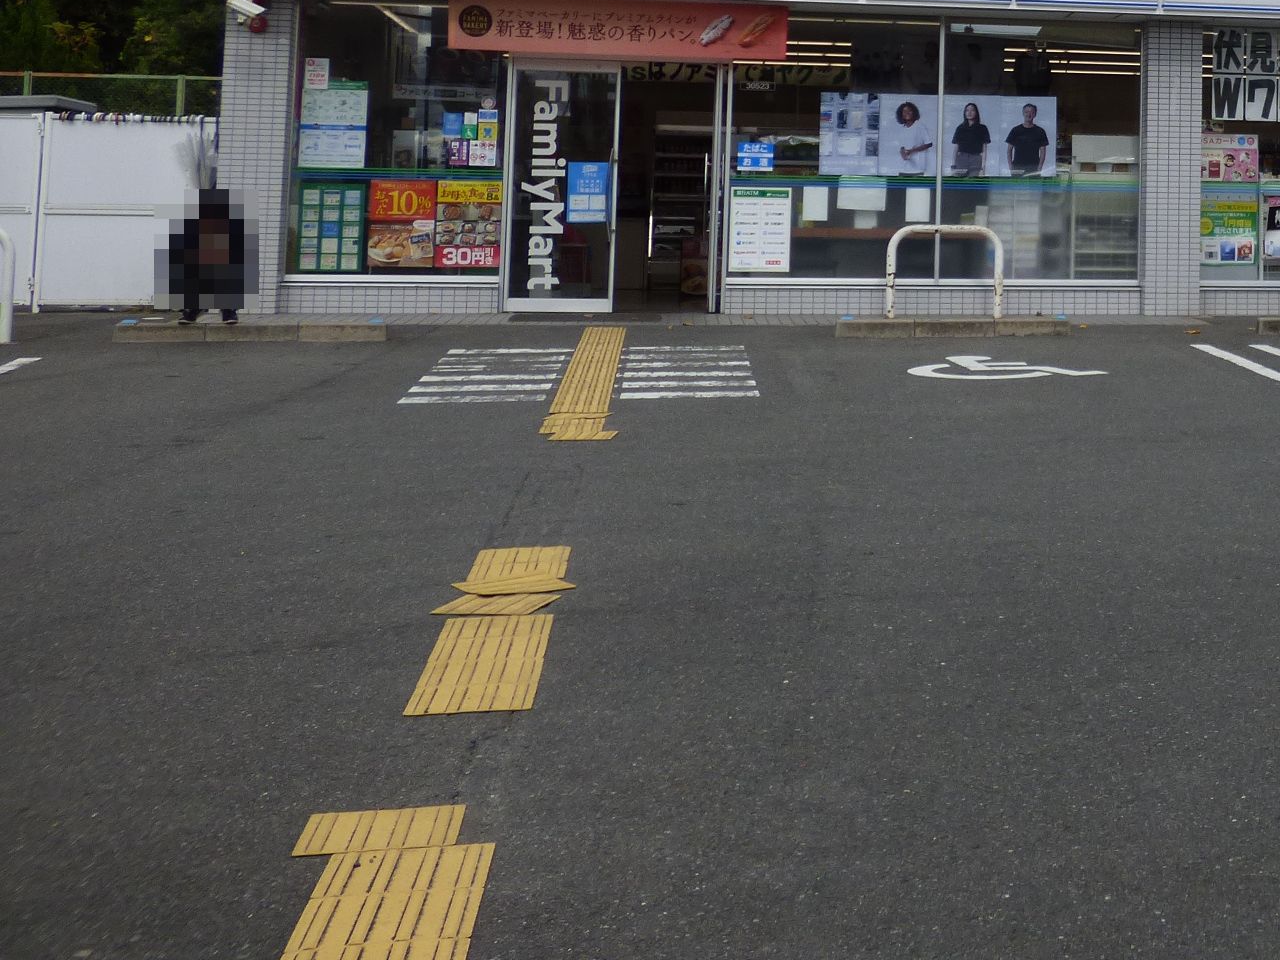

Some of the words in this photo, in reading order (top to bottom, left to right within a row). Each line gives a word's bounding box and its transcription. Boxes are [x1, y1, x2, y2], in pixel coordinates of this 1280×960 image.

[521, 79, 572, 291] FamilyMart
[743, 143, 768, 152] たばこ
